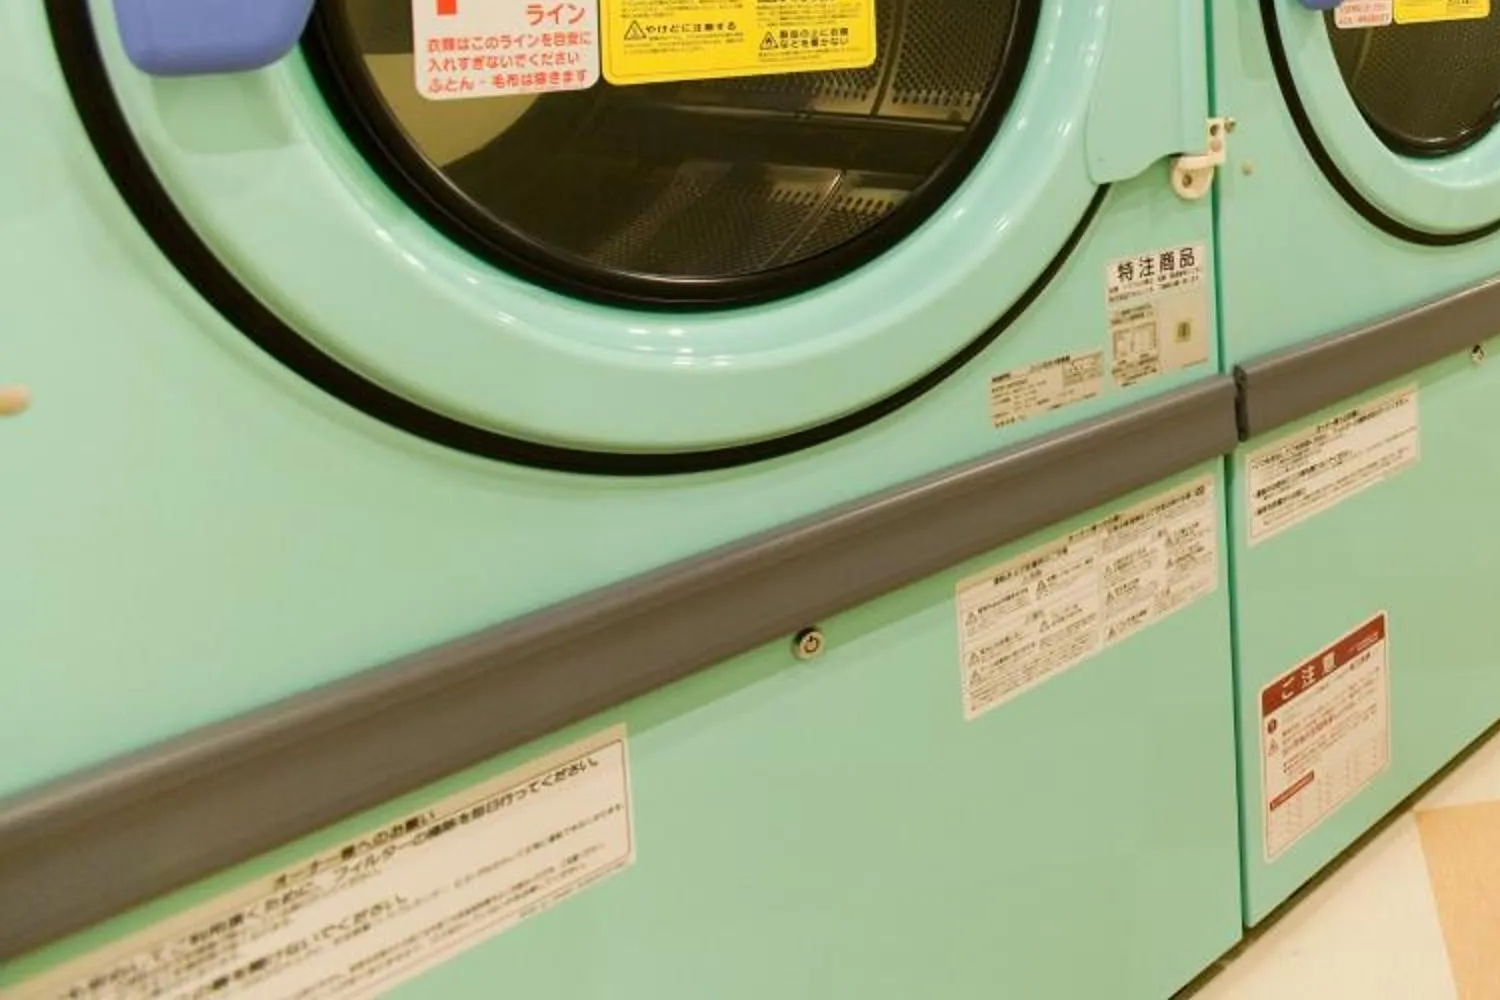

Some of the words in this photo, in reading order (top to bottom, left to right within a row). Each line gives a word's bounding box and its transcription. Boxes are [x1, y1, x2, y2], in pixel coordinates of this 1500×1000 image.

[526, 3, 585, 26] ライン
[427, 31, 592, 53] 衣類はこのラインを目安に
[428, 52, 580, 73] 入れすぎないでください
[1117, 245, 1196, 282] 特注商品
